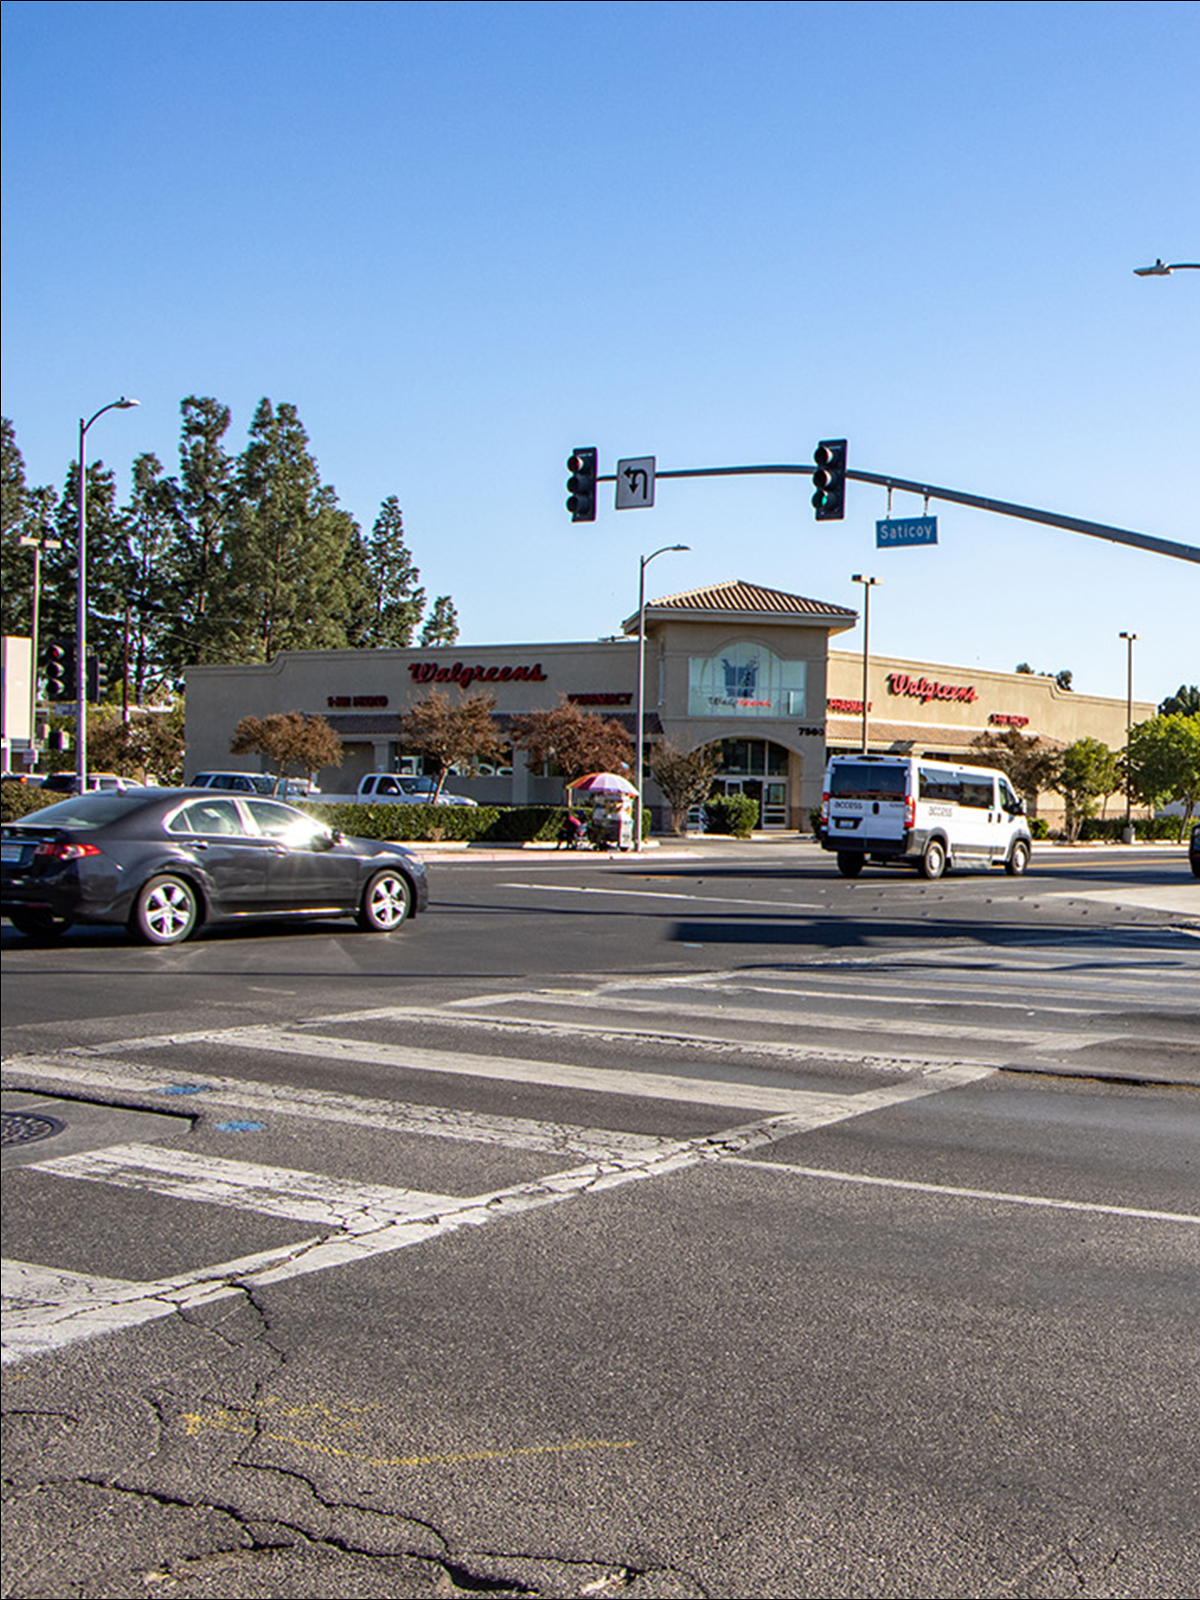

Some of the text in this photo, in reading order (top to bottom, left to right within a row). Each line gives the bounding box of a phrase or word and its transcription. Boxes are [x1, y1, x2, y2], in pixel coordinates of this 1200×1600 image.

[880, 525, 932, 539] Saticoy
[408, 663, 548, 689] Walgreens
[887, 673, 979, 704] Walgreens
[834, 801, 863, 810] access
